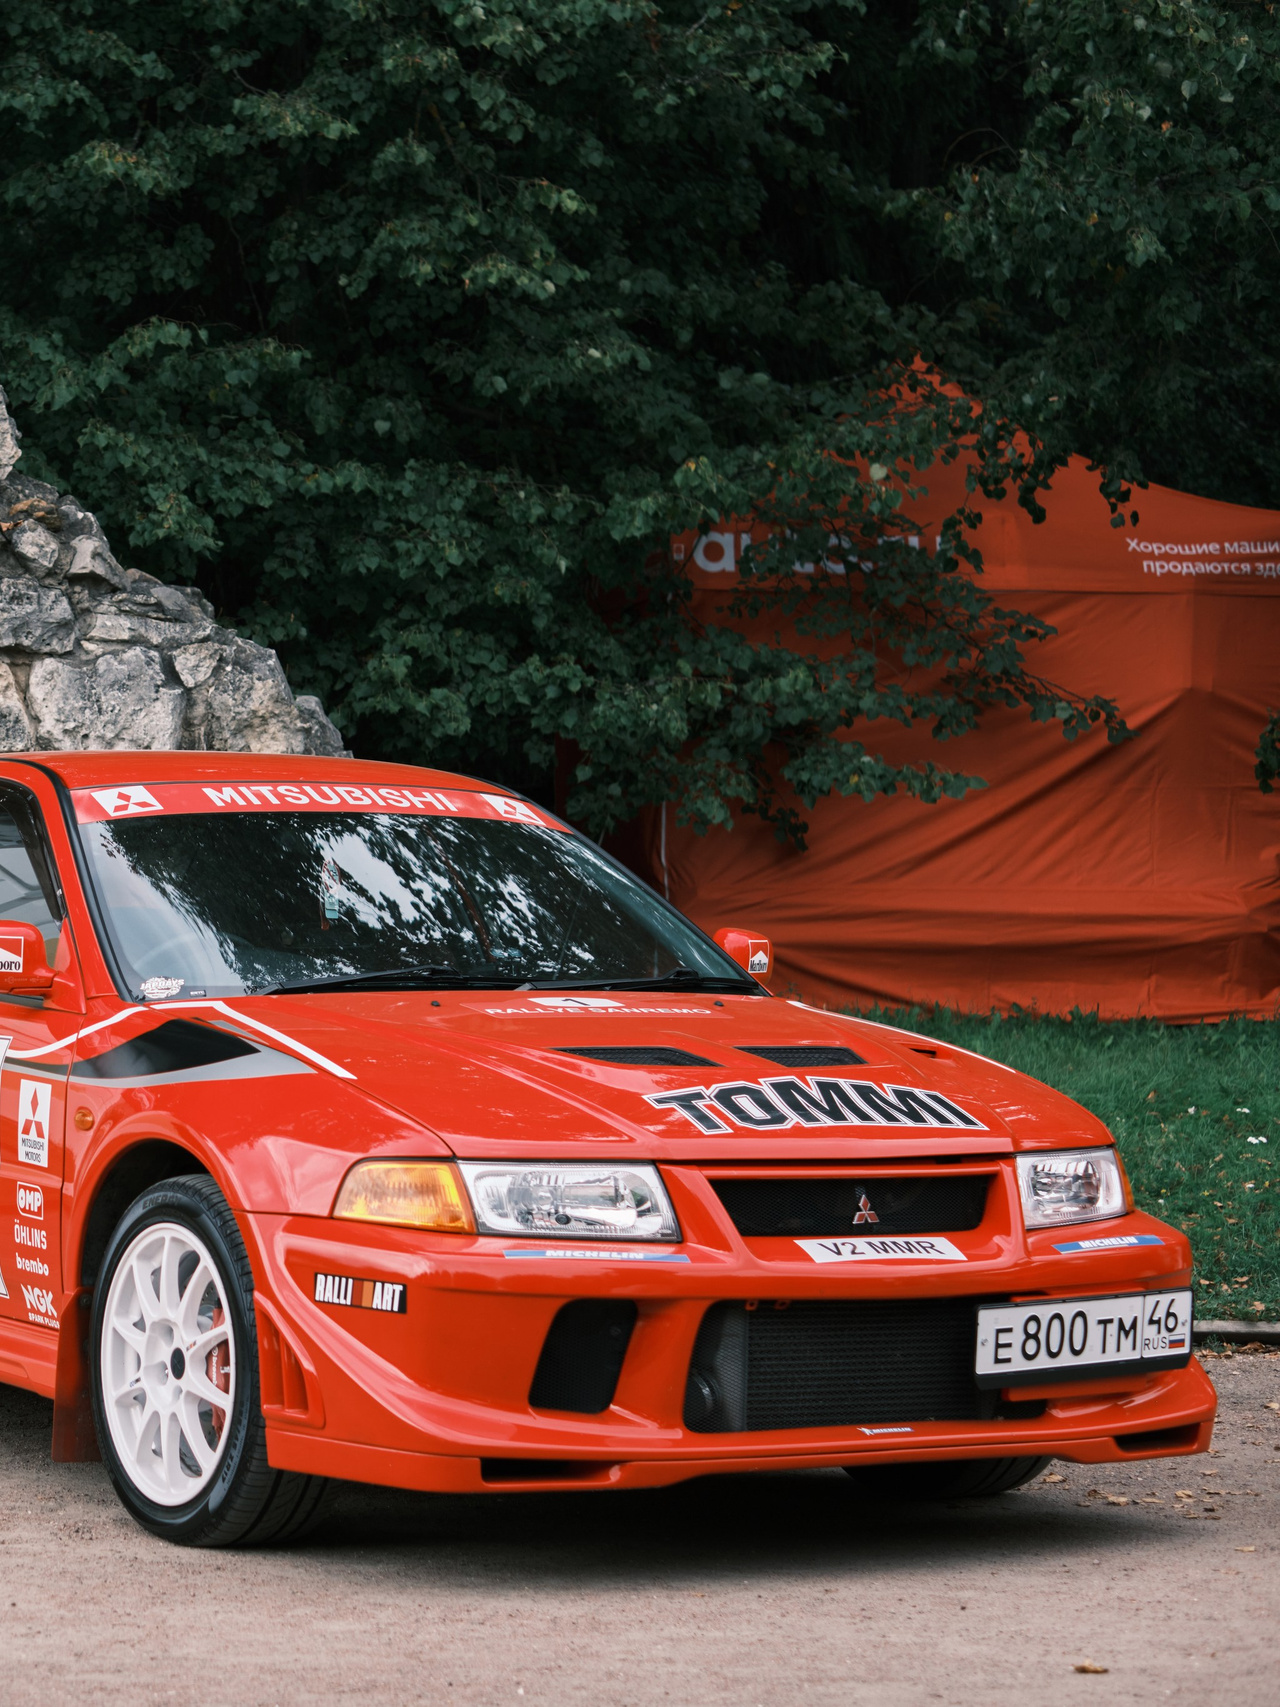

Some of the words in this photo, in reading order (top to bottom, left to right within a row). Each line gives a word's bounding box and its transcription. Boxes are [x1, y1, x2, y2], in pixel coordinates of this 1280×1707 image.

[1125, 537, 1221, 556] Хорошие
[1224, 541, 1280, 555] маши
[1143, 561, 1251, 577] продаются
[202, 785, 458, 812] MITSUBISHI
[561, 998, 591, 1007] 1
[592, 1007, 712, 1015] SANREMO
[642, 1076, 990, 1135] TOMMI
[21, 1138, 44, 1152] MITSUBISHI
[24, 1150, 42, 1164] MOTORS
[18, 1188, 42, 1213] OMP
[14, 1218, 47, 1250] ÖHLINS
[1077, 1236, 1139, 1249] MICHELIN
[545, 1249, 644, 1259] MICHELIN
[817, 1242, 866, 1256] V2
[864, 1241, 946, 1255] MMR
[16, 1252, 50, 1276] brembo
[20, 1283, 58, 1318] NGK
[315, 1273, 353, 1306] RALLI
[372, 1281, 403, 1312] ART
[28, 1312, 45, 1324] SPARK
[44, 1315, 60, 1329] PLUGS
[1147, 1298, 1179, 1335] 46
[1144, 1336, 1168, 1351] RUS
